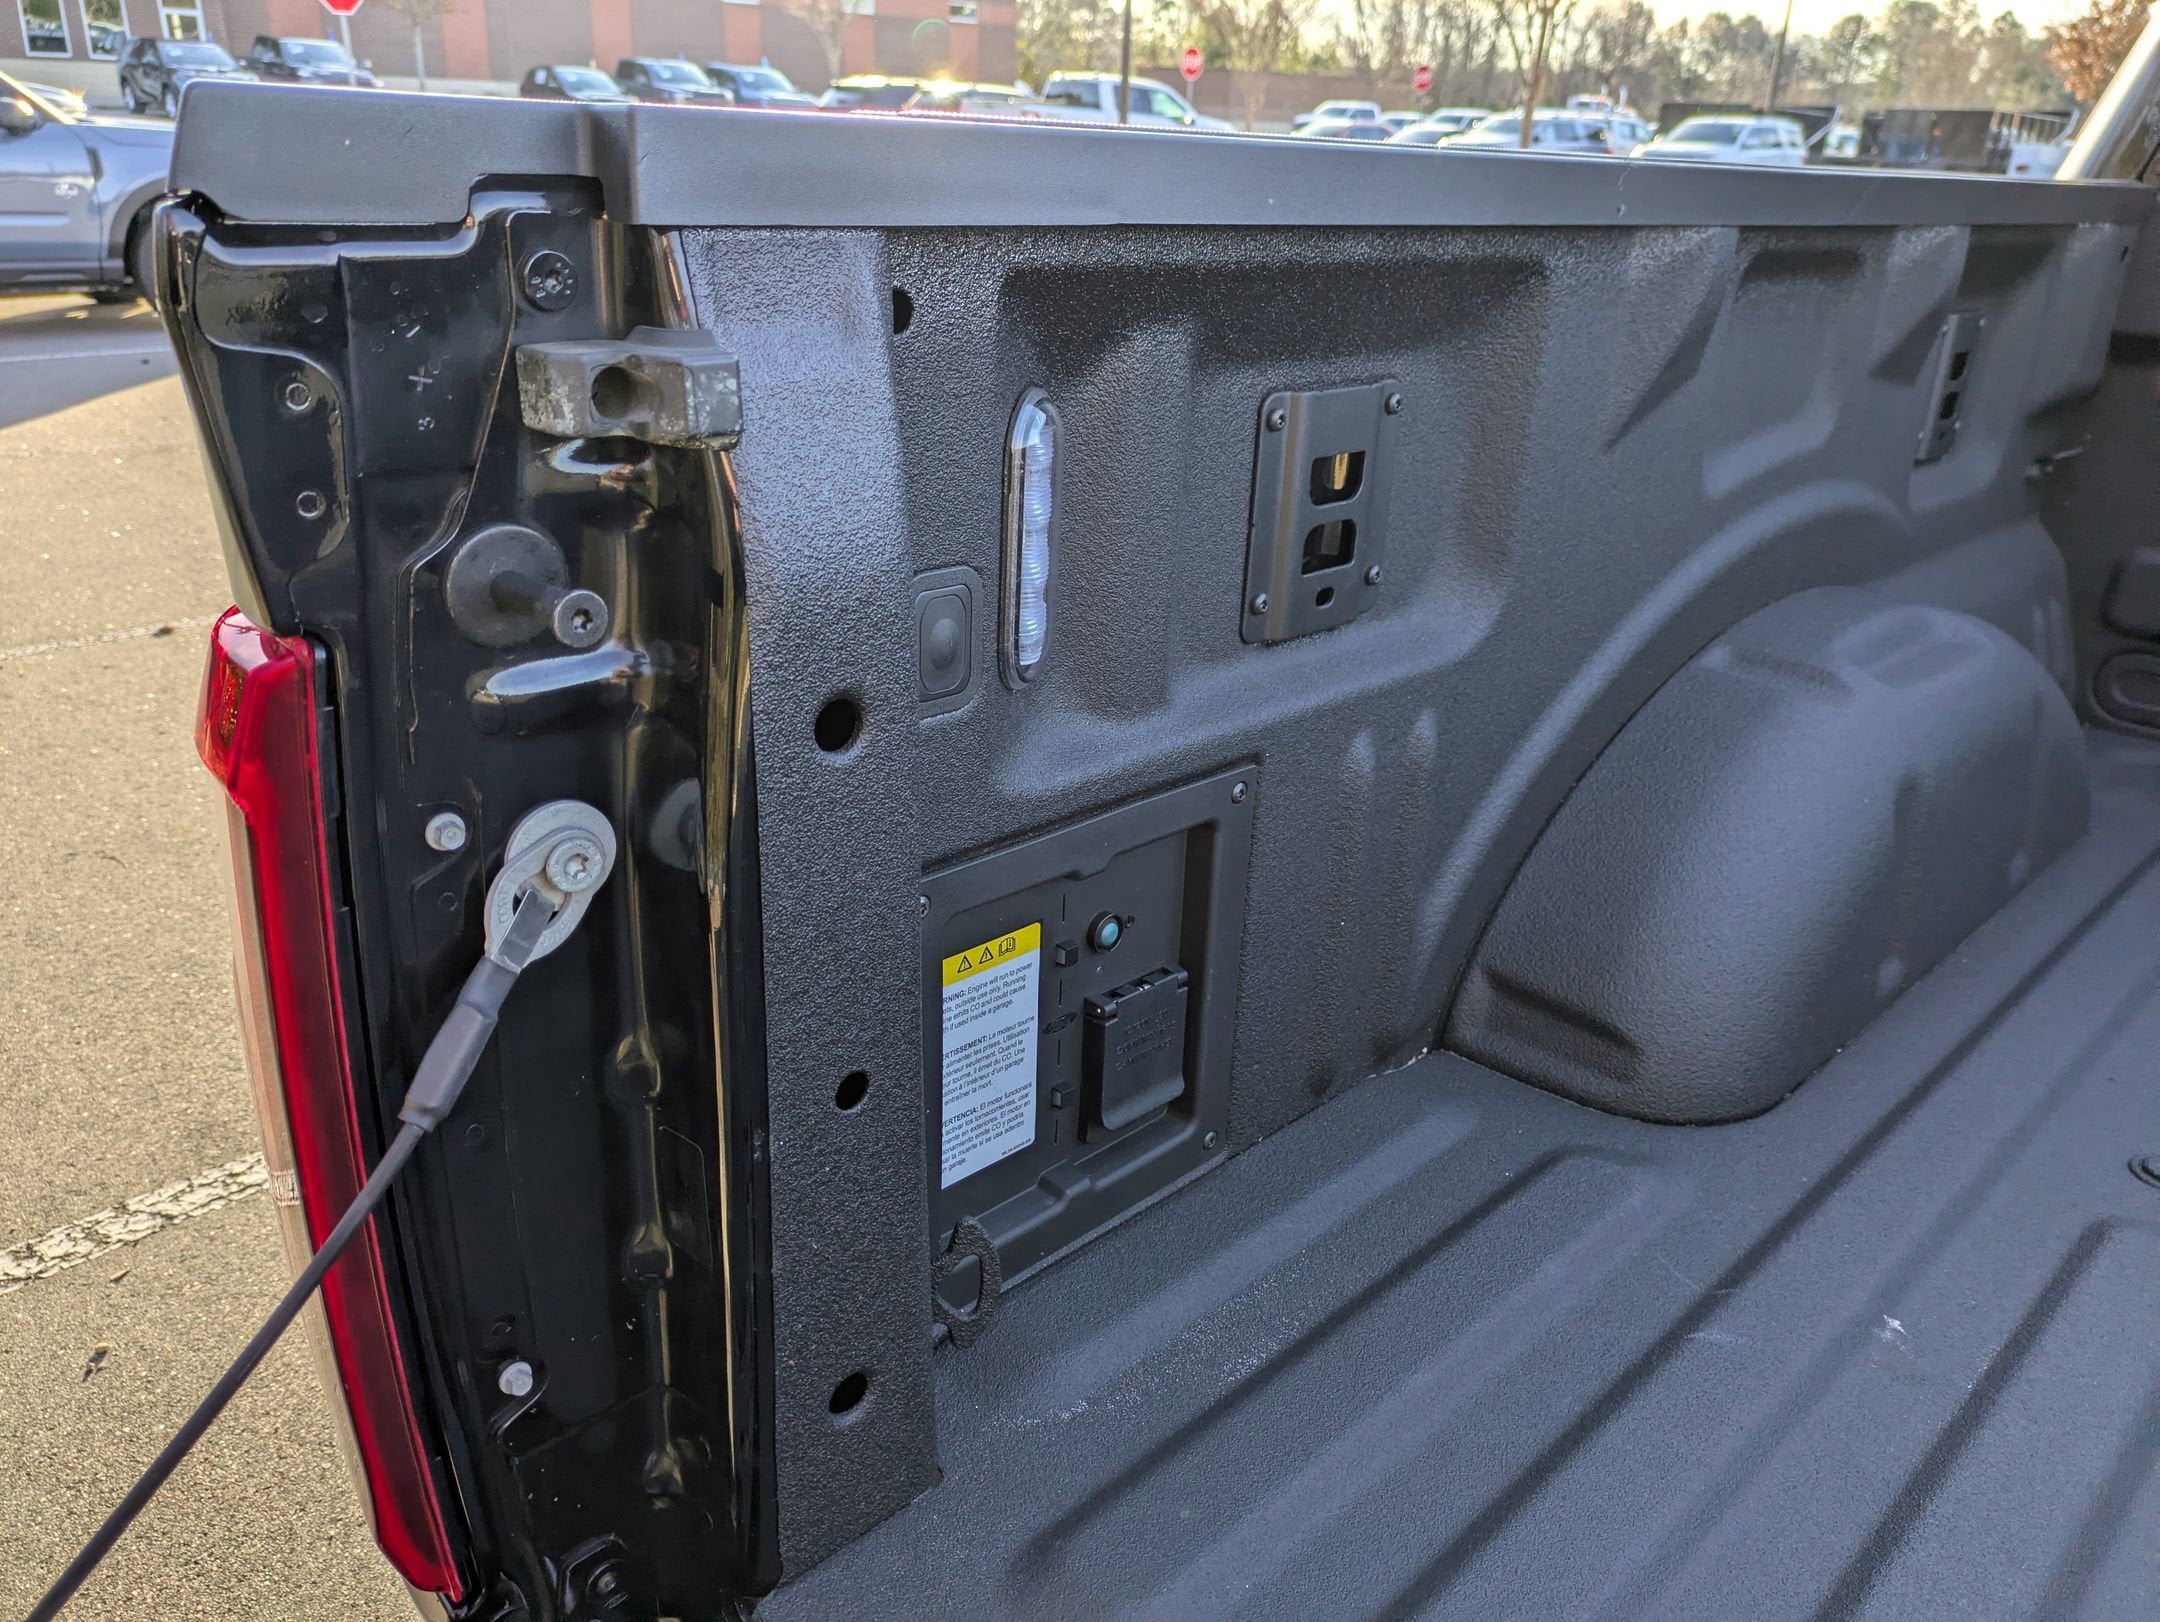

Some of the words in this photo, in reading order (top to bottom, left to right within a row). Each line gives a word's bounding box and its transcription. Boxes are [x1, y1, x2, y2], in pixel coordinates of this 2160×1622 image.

[968, 981, 988, 994] Engine
[989, 976, 998, 985] will
[999, 973, 1008, 981] run
[1016, 962, 1032, 974] power
[955, 997, 976, 1009] outside
[977, 992, 988, 1002] use
[1003, 975, 1026, 988] Running
[954, 1008, 969, 1019] emits
[970, 1002, 980, 1012] CO
[981, 997, 992, 1007] and
[993, 990, 1008, 1002] could
[1009, 984, 1026, 995] cause
[954, 1016, 968, 1029] used
[970, 1009, 986, 1022] inside
[997, 1024, 1016, 1036] moteur
[1018, 1016, 1034, 1027] tourne
[1003, 1027, 1030, 1042] Utilisation
[998, 1041, 1017, 1054] Quand
[1014, 1047, 1025, 1056] Une
[1004, 1057, 1024, 1072] garage
[987, 1096, 1003, 1107] motor
[1007, 1103, 1023, 1114] motor
[945, 1122, 964, 1135] activar
[1018, 1092, 1030, 1102] usar
[975, 1127, 990, 1139] emite
[992, 1122, 1001, 1132] CO
[958, 1143, 977, 1156] muerte
[993, 1131, 1003, 1139] usa
